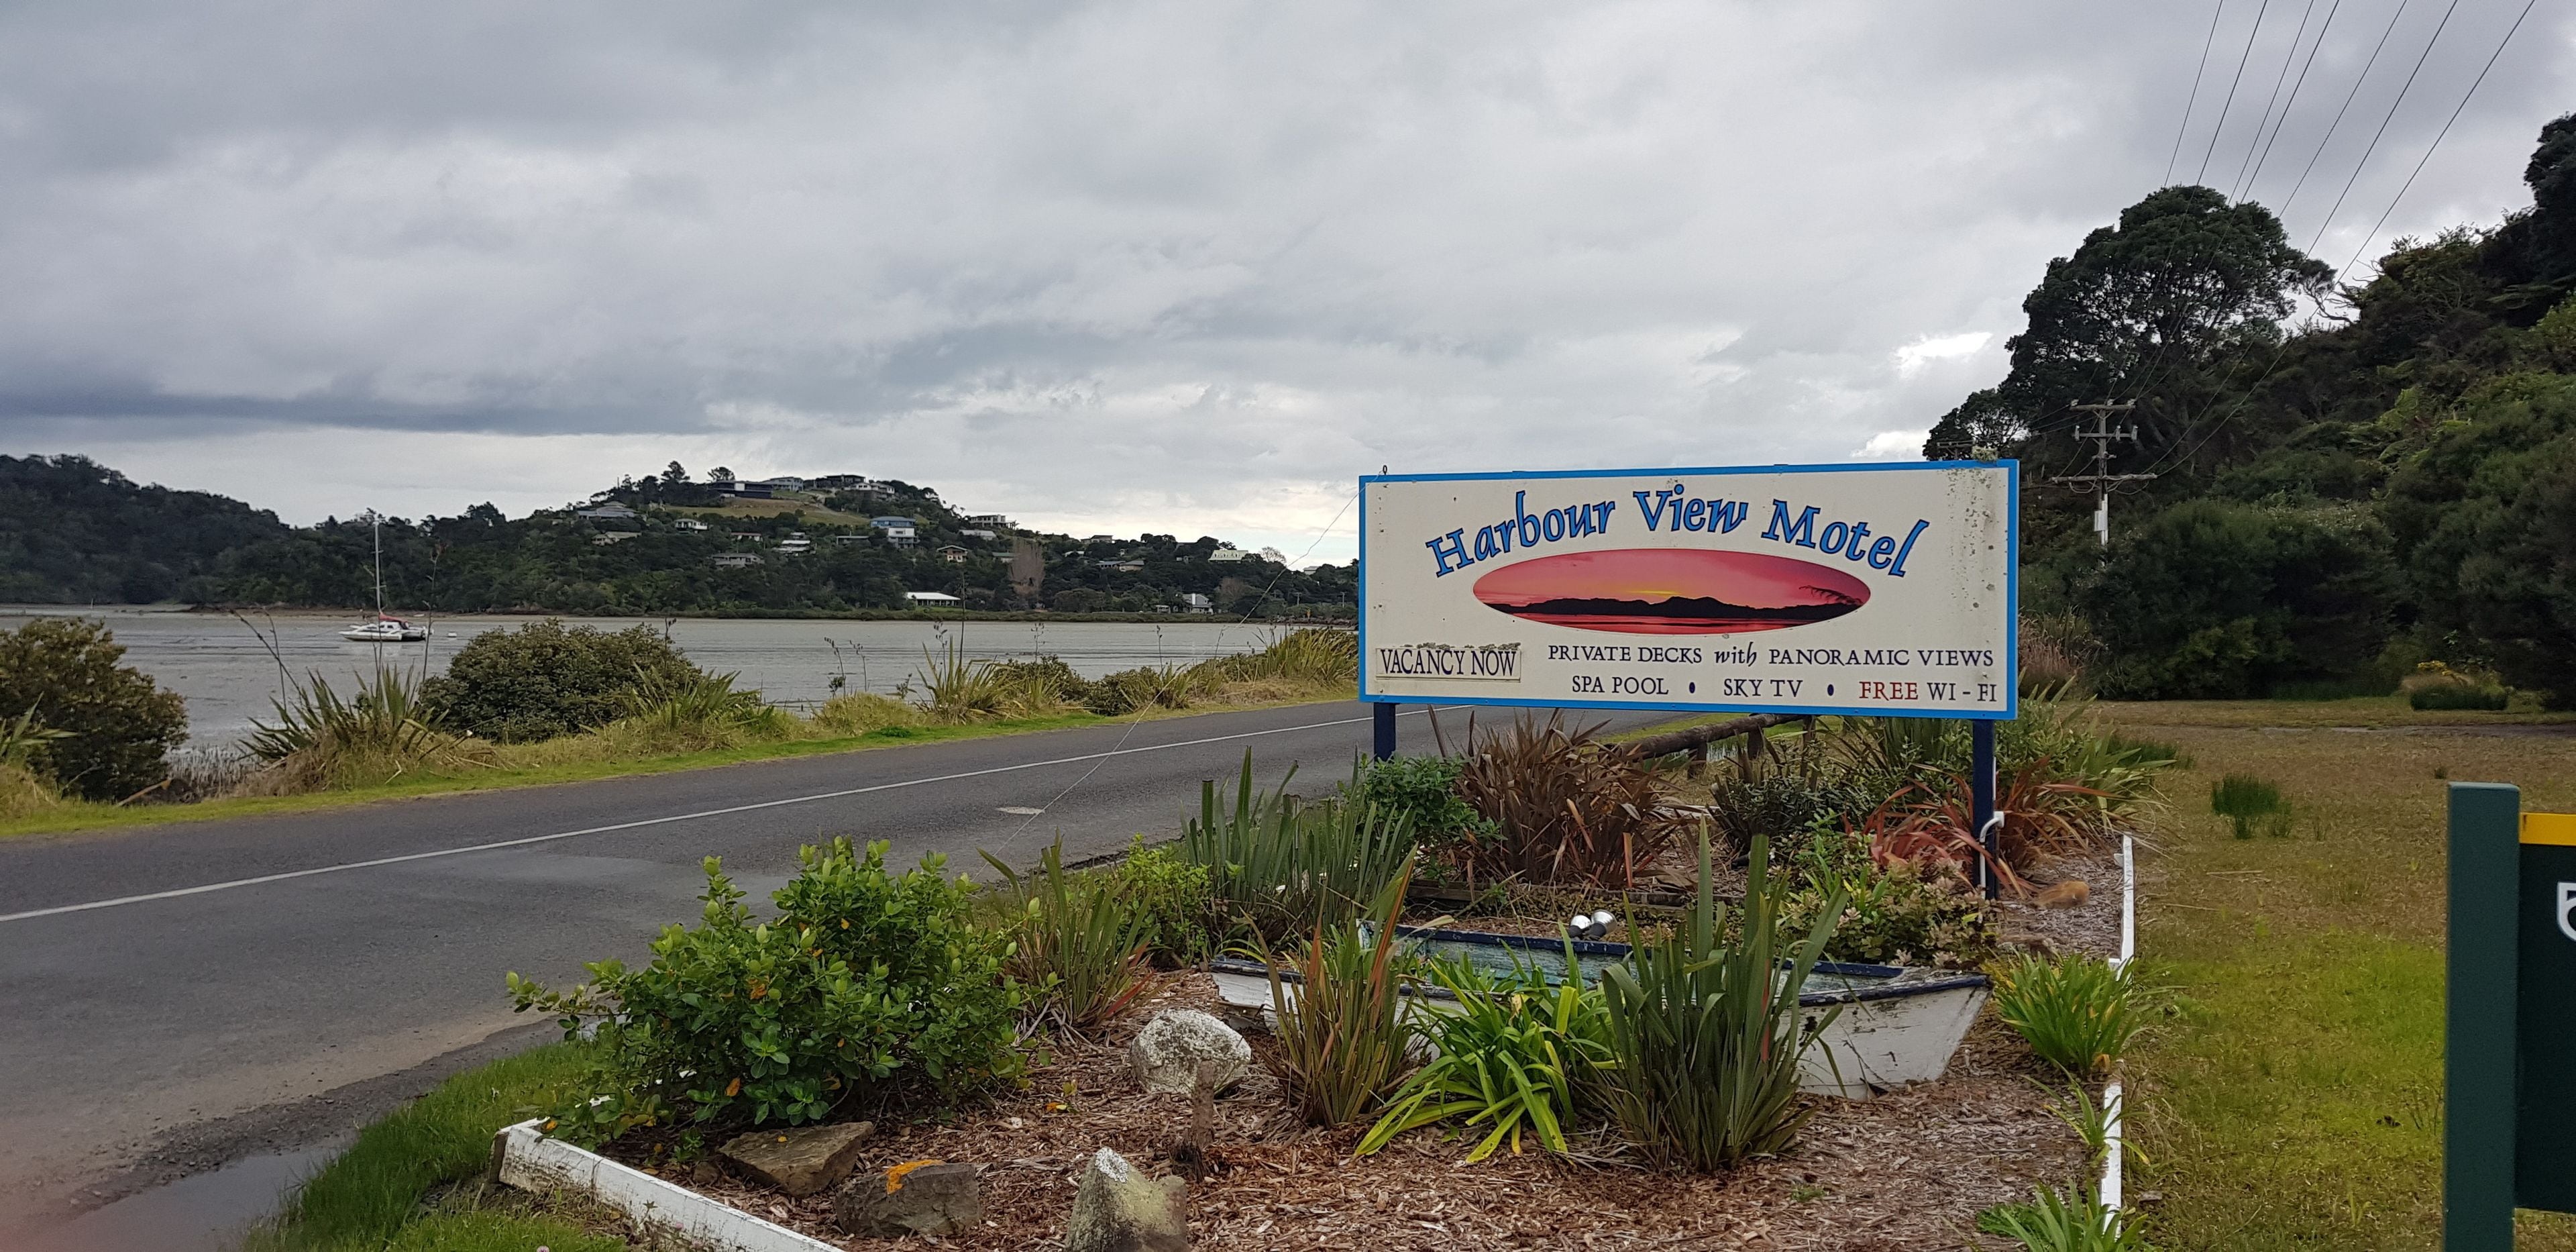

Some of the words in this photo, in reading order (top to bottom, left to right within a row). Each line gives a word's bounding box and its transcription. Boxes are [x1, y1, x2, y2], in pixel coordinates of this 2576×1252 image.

[1425, 490, 1616, 578] Harbour
[1632, 483, 1749, 534] View
[1760, 499, 1930, 578] Motel
[1381, 649, 1465, 675] VACANCY
[1470, 649, 1517, 676] NOW
[1548, 645, 1631, 662] PRIVATE
[1638, 646, 1703, 664] DECKS
[1714, 641, 1757, 667] with
[1769, 649, 1911, 666] PANORAMIC
[1917, 649, 1994, 666] VIEWS
[1572, 675, 1605, 693] SPA
[1611, 676, 1670, 695] POOL
[1723, 678, 1764, 698] SKY
[1770, 679, 1804, 698] TV
[1858, 681, 1919, 701] FREE
